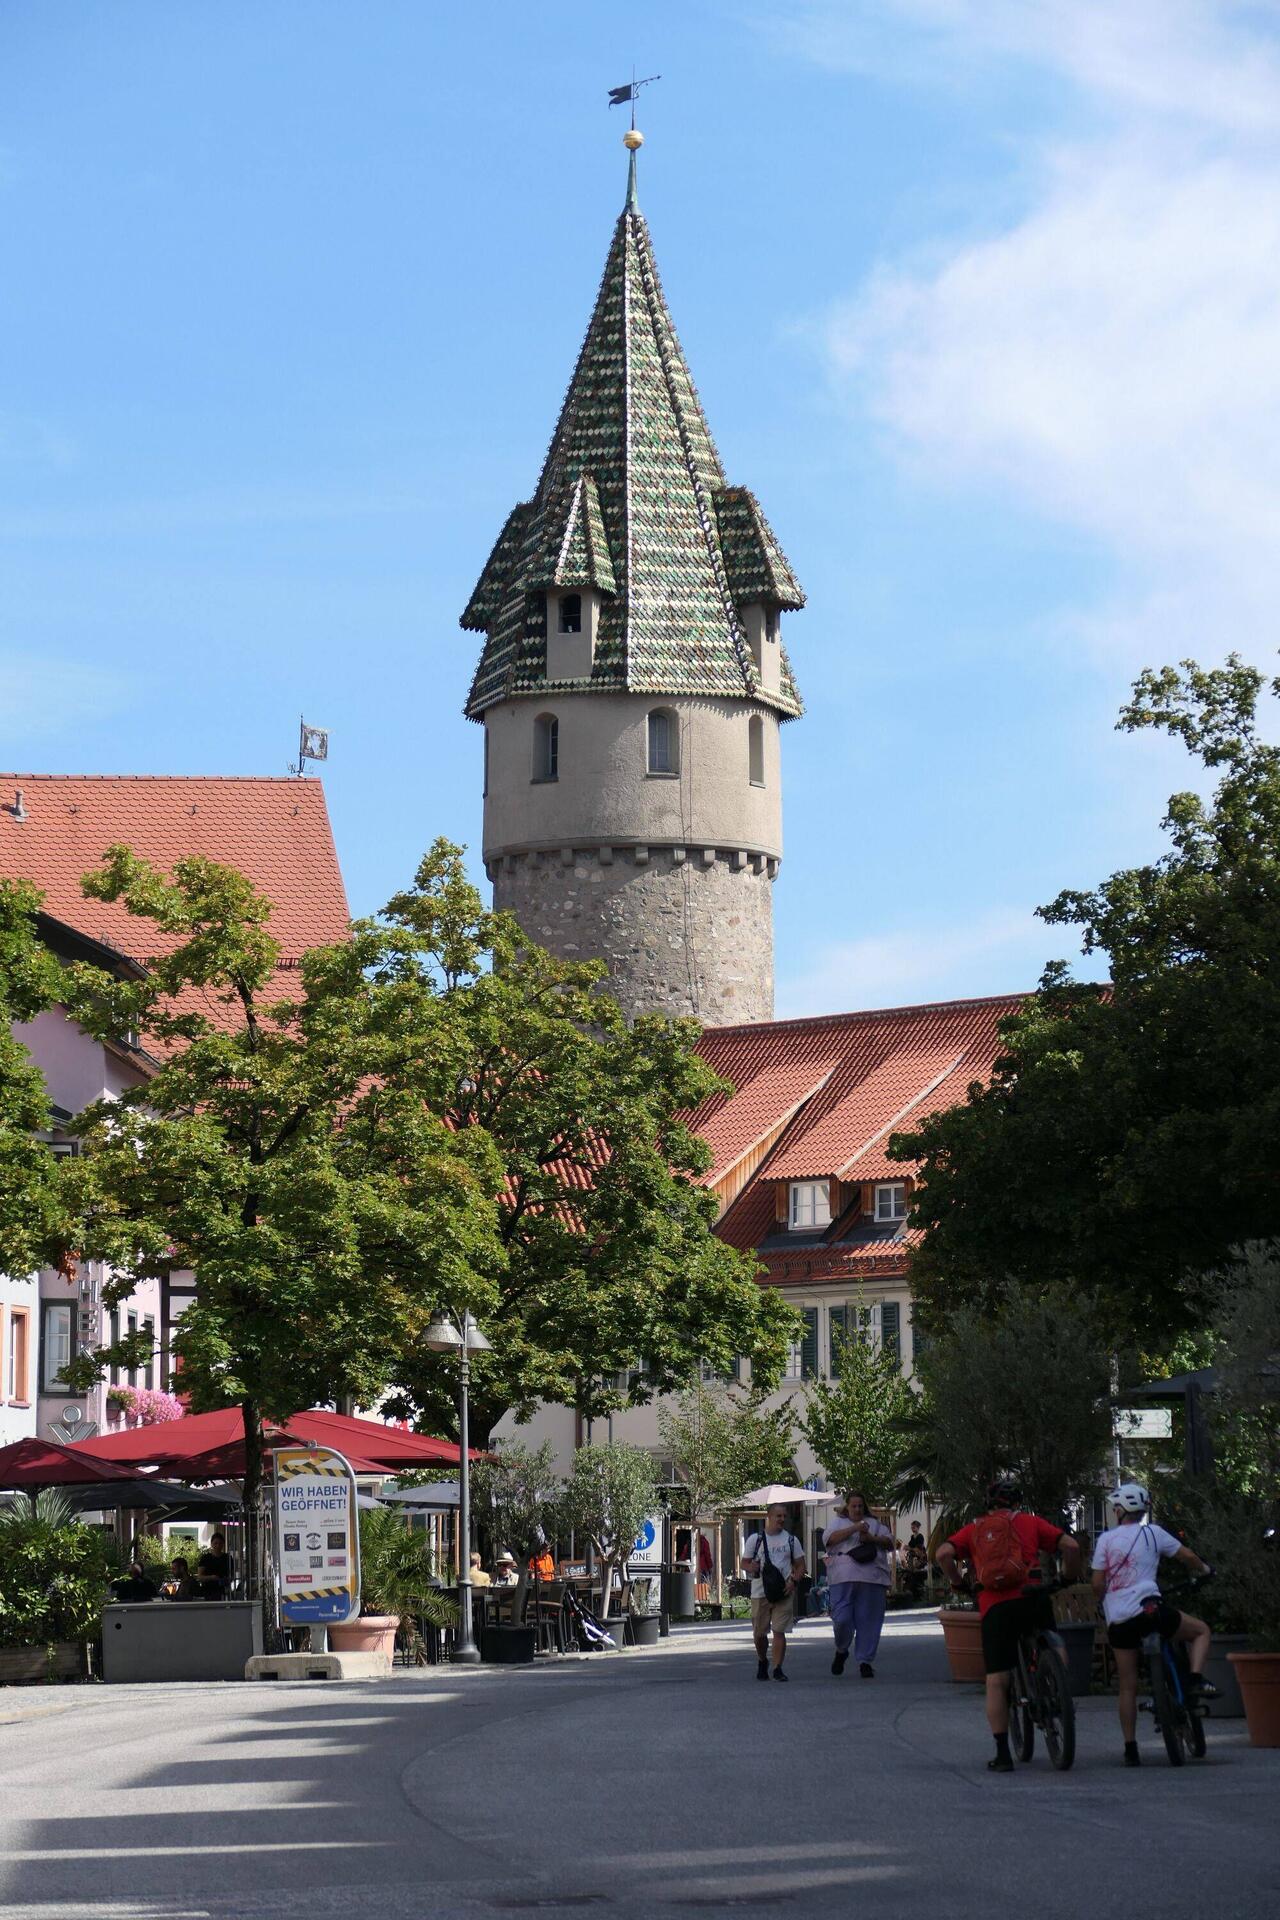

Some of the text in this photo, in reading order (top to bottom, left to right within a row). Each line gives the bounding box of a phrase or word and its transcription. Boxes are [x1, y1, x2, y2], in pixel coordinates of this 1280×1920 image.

[281, 1485, 347, 1497] WIR HABEN
[281, 1497, 346, 1511] GEÖFFNET!
[628, 1552, 652, 1561] ONE
